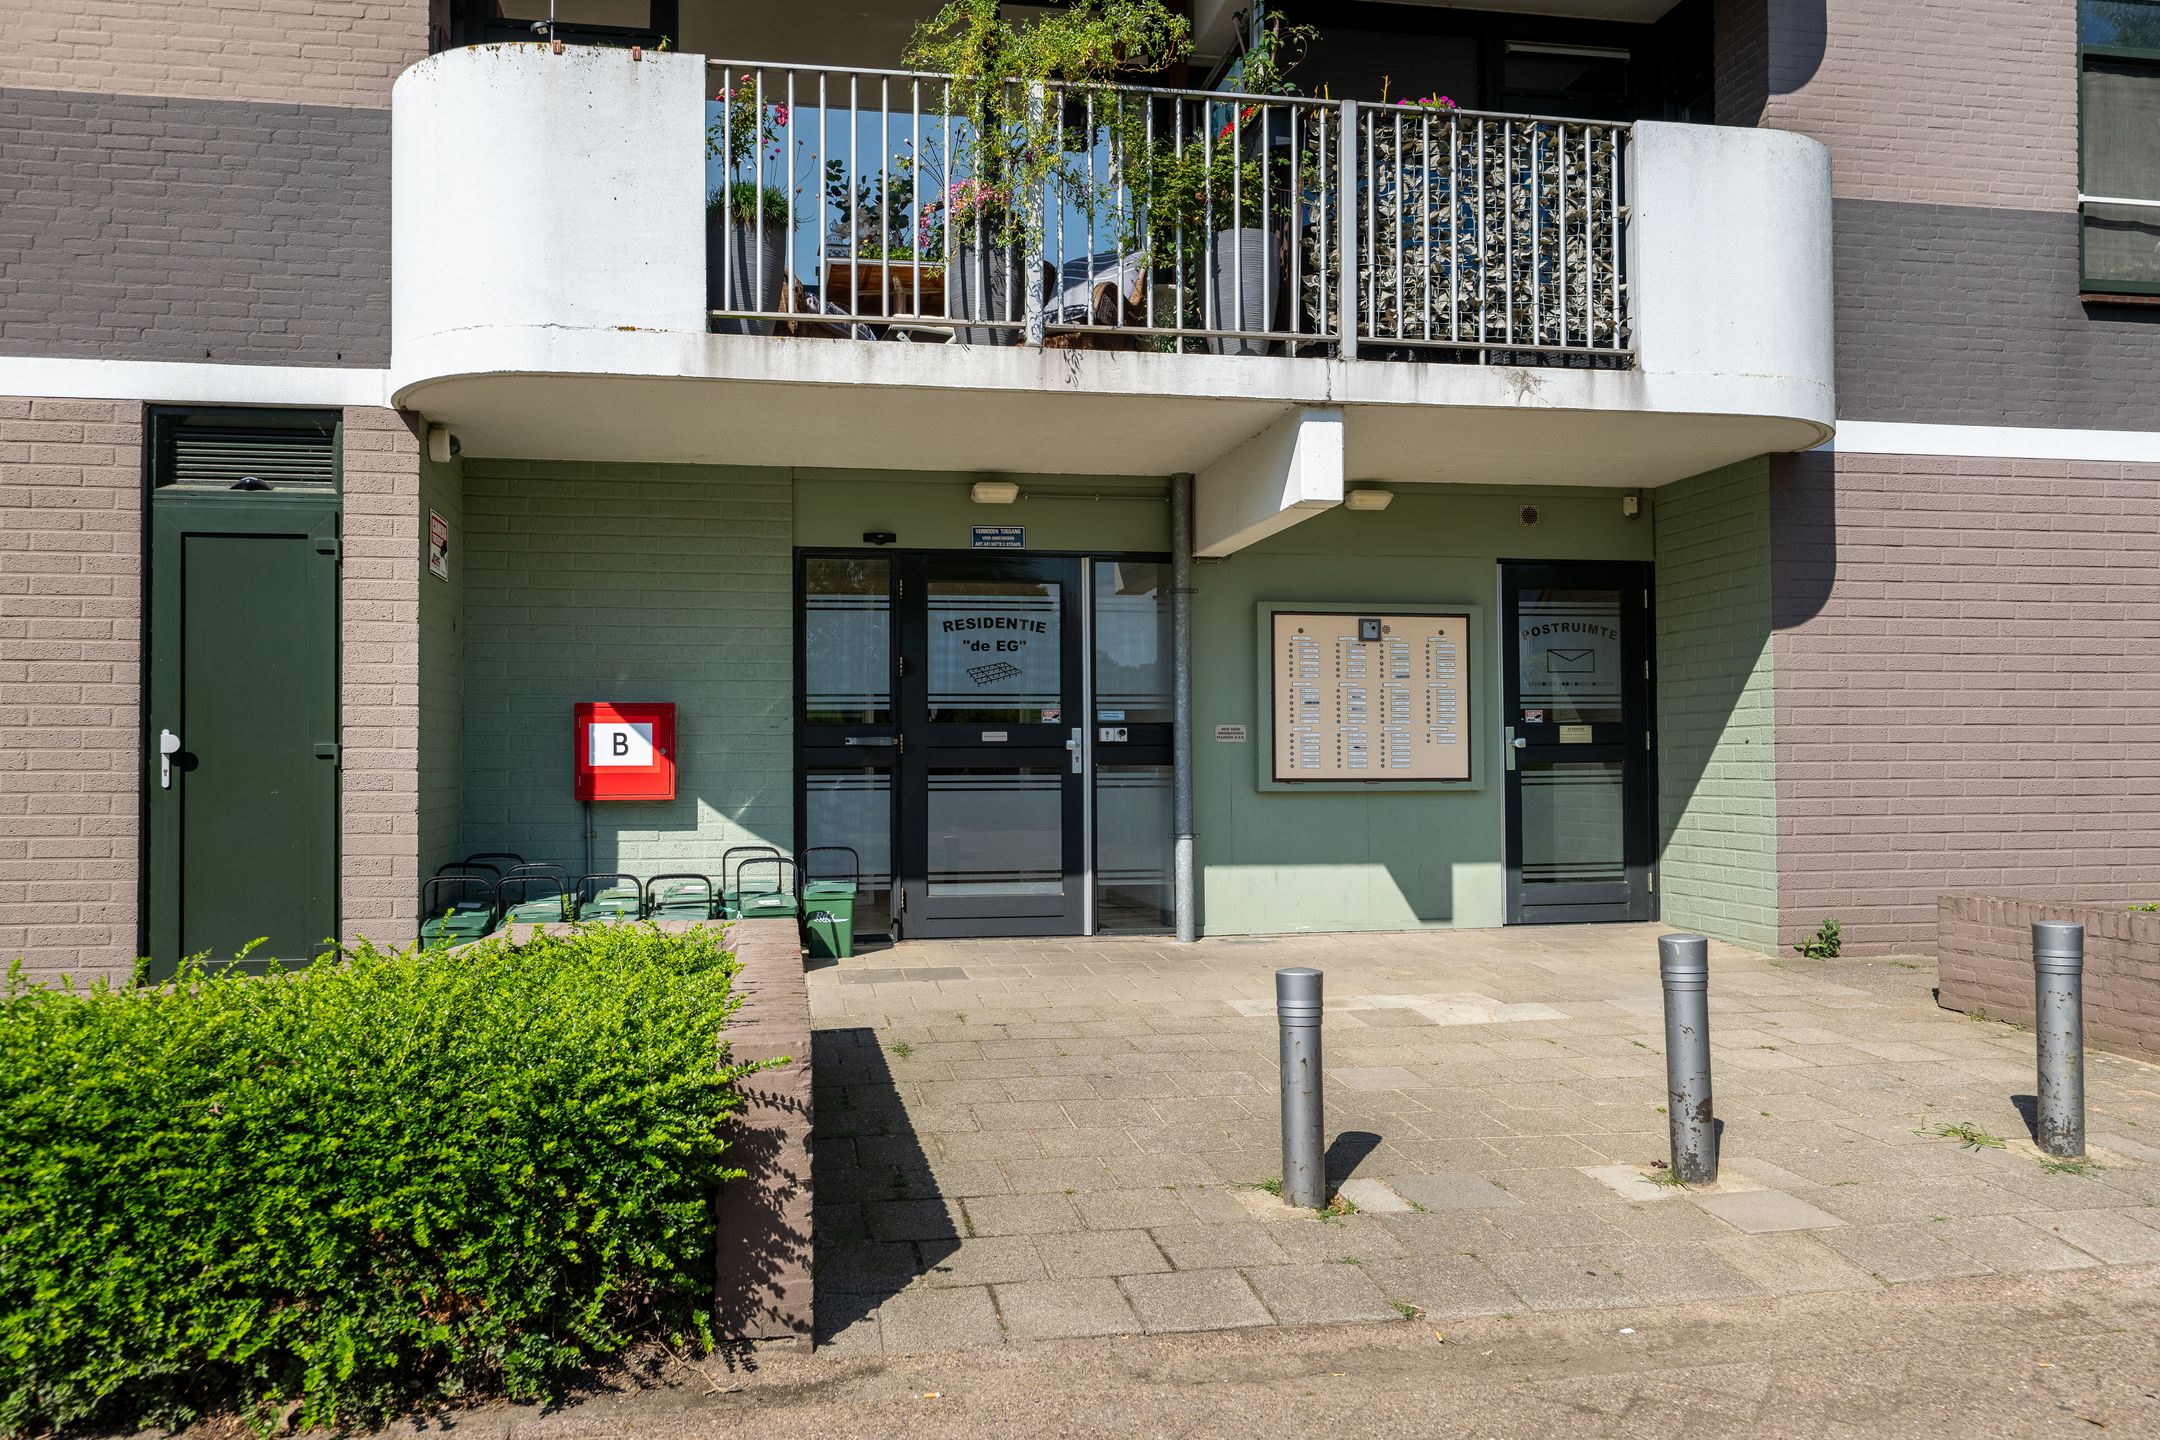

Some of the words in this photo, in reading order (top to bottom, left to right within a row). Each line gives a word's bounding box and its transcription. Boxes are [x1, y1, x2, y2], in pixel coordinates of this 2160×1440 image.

[942, 617, 1047, 634] RESIDENTIE
[1521, 622, 1618, 641] POSTRUIMTE
[963, 640, 991, 652] "de
[996, 640, 1027, 652] EG"
[613, 732, 629, 756] B
